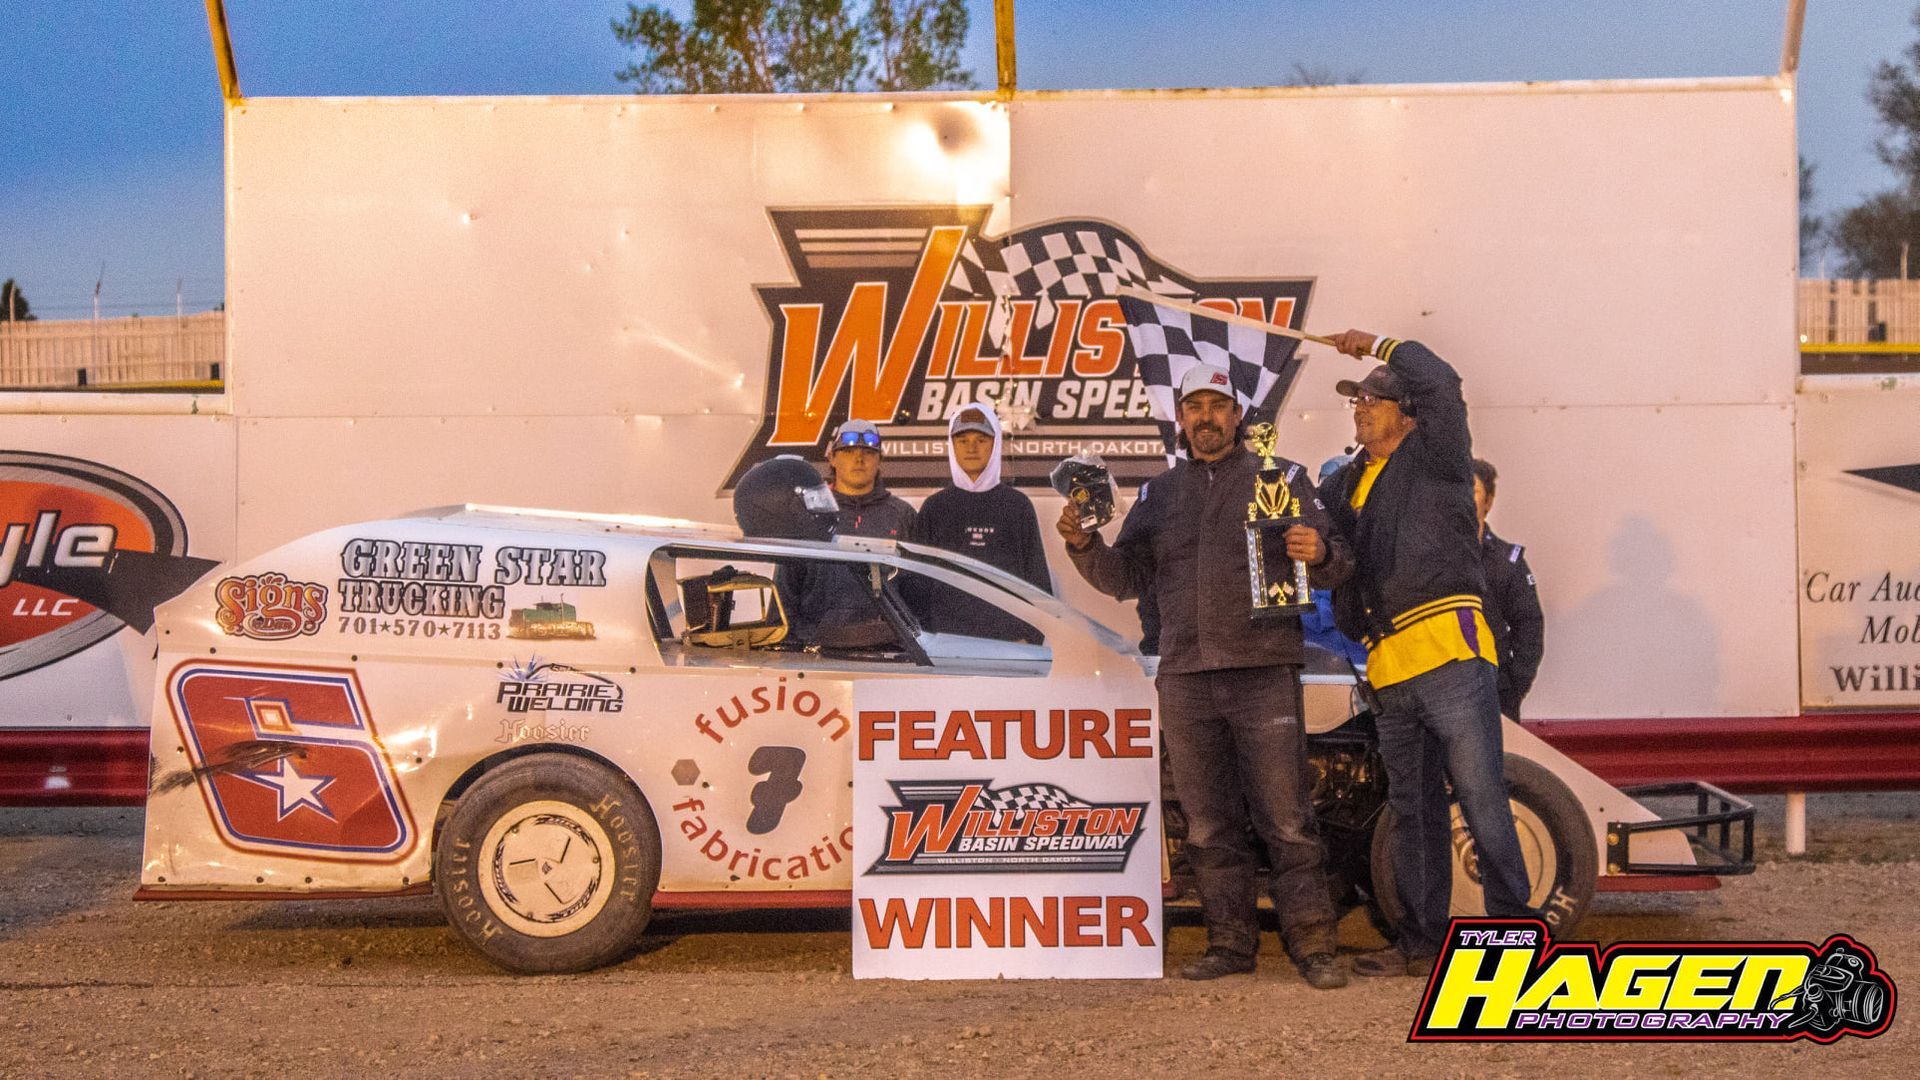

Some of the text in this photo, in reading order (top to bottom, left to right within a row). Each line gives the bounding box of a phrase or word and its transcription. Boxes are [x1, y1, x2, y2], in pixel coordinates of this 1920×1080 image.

[766, 225, 1296, 446] WILLIS
[1052, 380, 1157, 418] SPEE
[1011, 441, 1081, 454] NORTH
[341, 538, 607, 586] GREEN STAR
[12, 598, 79, 616] LLC
[215, 572, 328, 640] Signs
[338, 578, 505, 619] TRUCKING
[1806, 571, 1861, 603] Car
[497, 682, 614, 703] PRAIRIE
[507, 697, 623, 713] WELDING
[694, 676, 851, 745] fusion
[494, 718, 591, 743] Hoosier
[858, 709, 1153, 761] FEATURE
[166, 658, 419, 865] 6
[746, 746, 807, 835] 7
[885, 785, 1141, 861] WILLISTON
[958, 835, 1131, 853] BASIN SPEEDWAY
[858, 896, 1156, 949] WINNER
